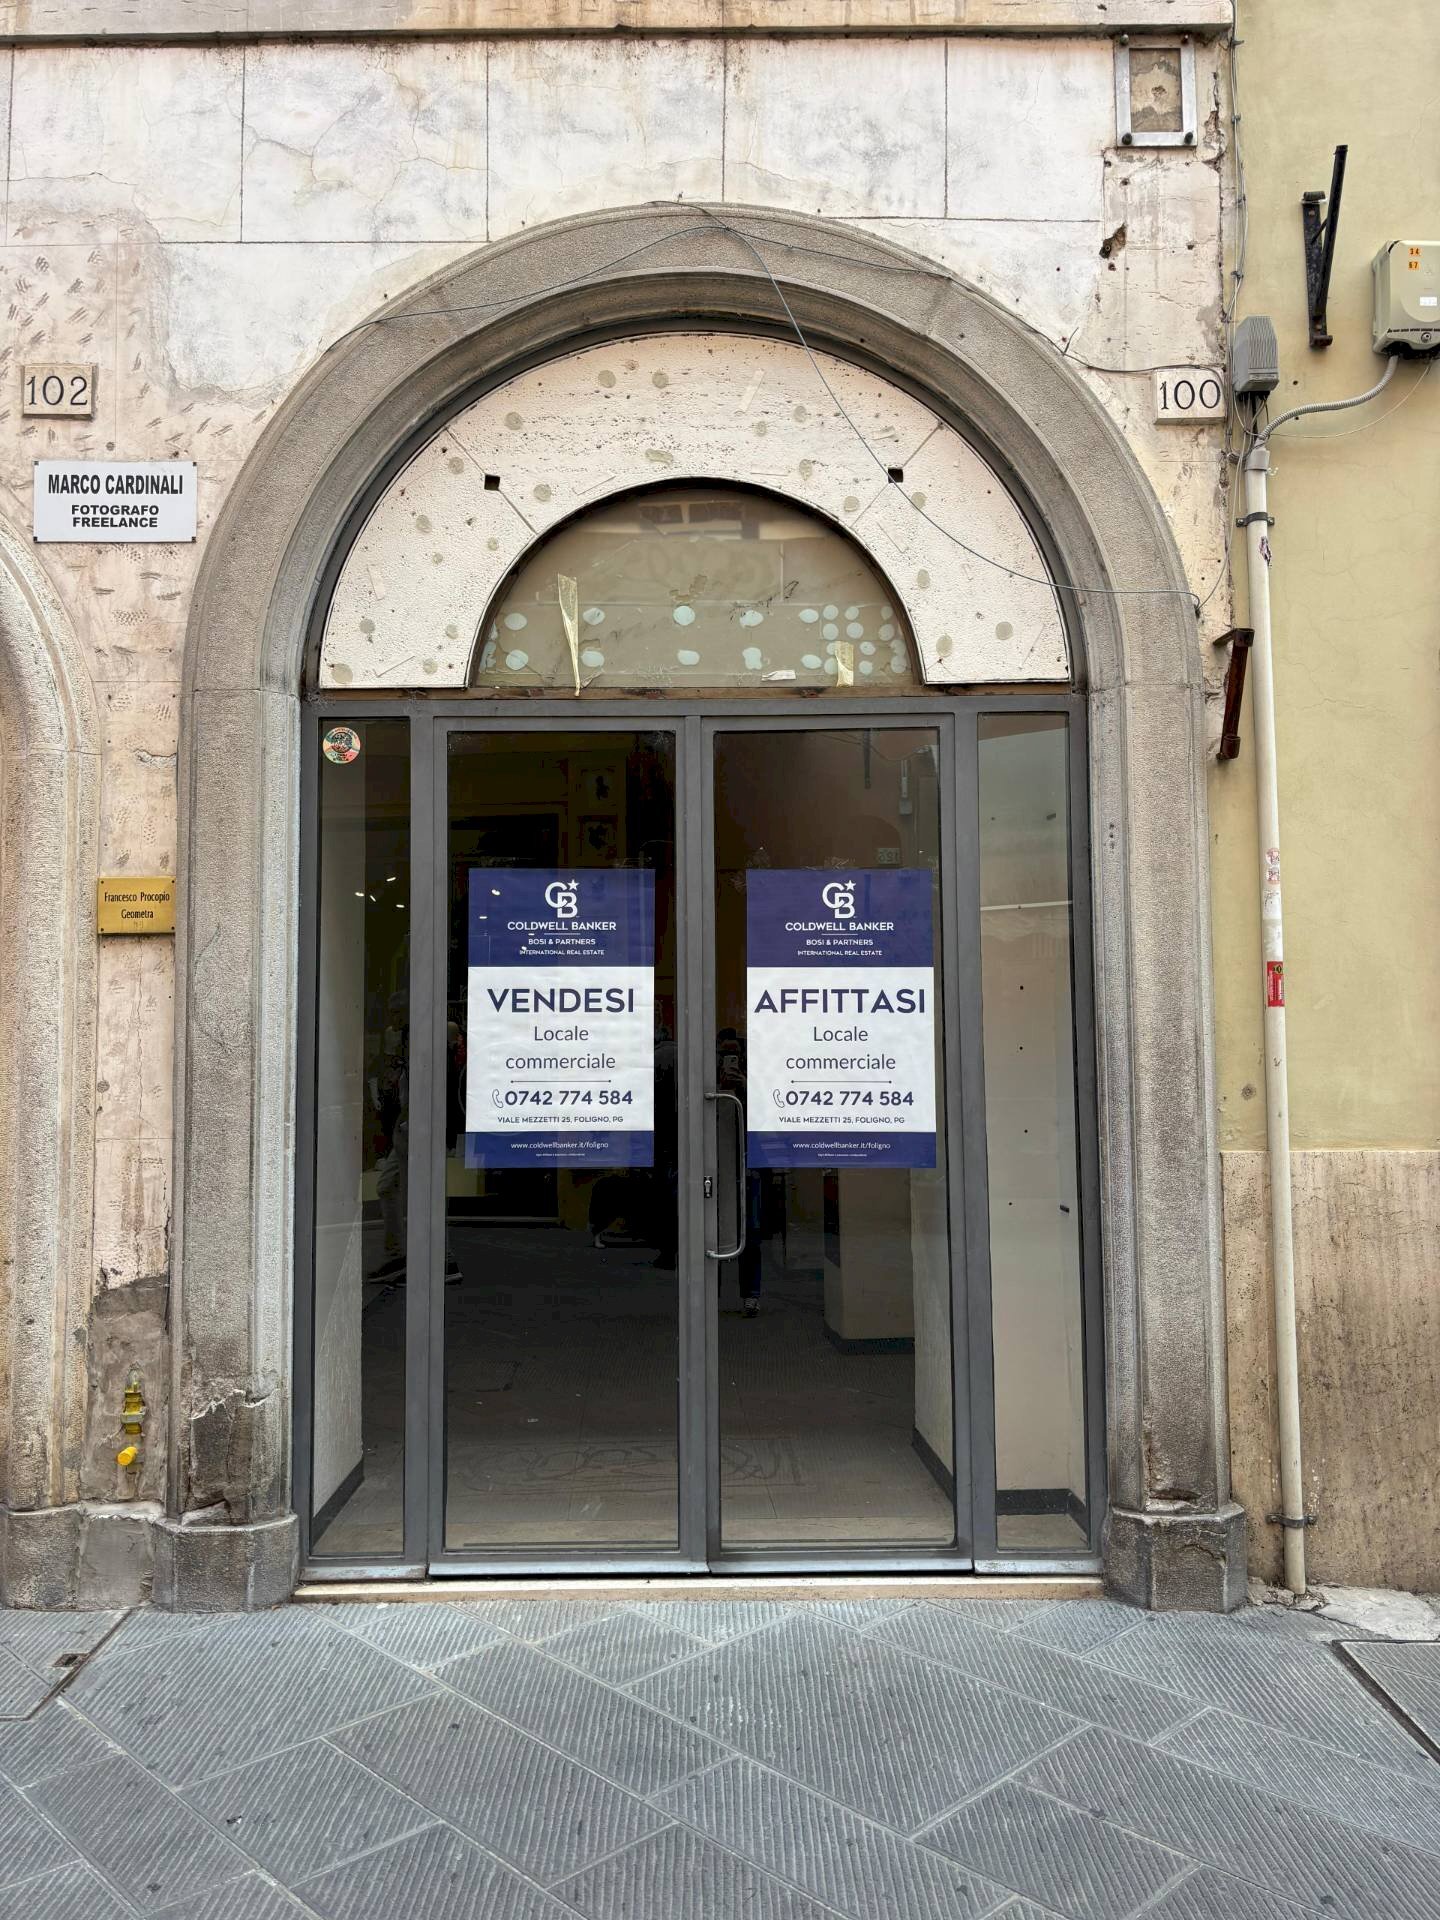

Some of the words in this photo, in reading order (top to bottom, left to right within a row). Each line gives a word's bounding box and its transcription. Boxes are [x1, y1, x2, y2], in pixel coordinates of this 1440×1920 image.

[26, 375, 88, 406] 102
[1160, 379, 1221, 410] 100
[48, 474, 100, 495] MARCO
[105, 474, 183, 495] CARDINALI
[71, 505, 159, 516] FOTOGRAFO
[72, 517, 158, 528] FREELANCE
[104, 892, 137, 902] Francesco
[140, 891, 170, 904] Procopio
[121, 908, 154, 919] Geometra
[507, 921, 568, 931] COLDWELL
[571, 921, 617, 931] BANKER
[785, 922, 846, 931] COLDWELL
[849, 922, 894, 931] BANKER
[487, 988, 634, 1013] VENDESI
[754, 988, 925, 1014] AFFITTASI
[534, 1025, 589, 1041] Locale
[813, 1026, 868, 1042] Locale
[505, 1053, 616, 1069] commerciale
[786, 1053, 896, 1070] commerciale
[504, 1090, 553, 1106] 0742
[559, 1090, 593, 1105] 774
[599, 1090, 633, 1105] 584
[785, 1091, 834, 1106] 0742
[839, 1091, 874, 1106] 774
[879, 1091, 914, 1106] 584
[561, 1116, 573, 1124] 25,
[574, 1116, 611, 1124] FOLIGNO,
[510, 1142, 609, 1150] www.coldwellbanker.it/foligno
[792, 1142, 891, 1151] www.coldwellbanker.it/foligno
